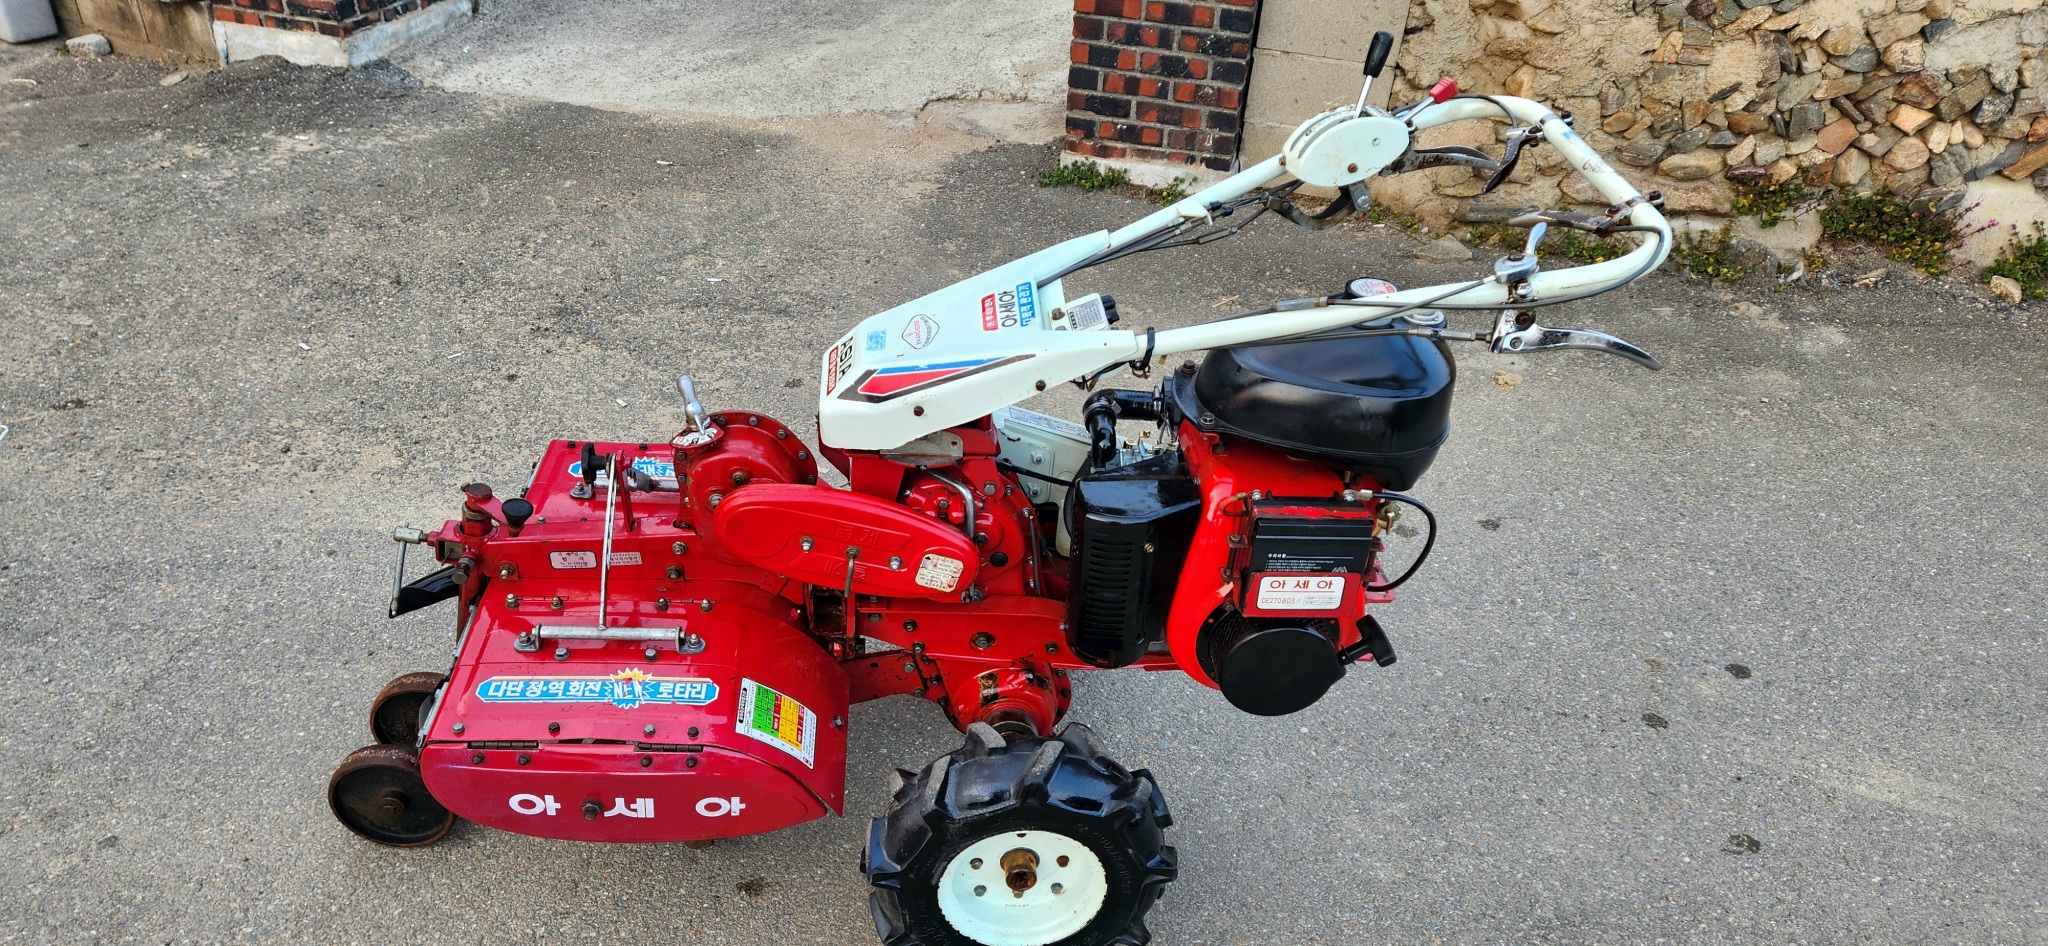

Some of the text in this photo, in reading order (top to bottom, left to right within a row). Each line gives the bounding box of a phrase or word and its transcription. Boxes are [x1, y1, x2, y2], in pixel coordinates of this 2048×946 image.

[997, 290, 1018, 328] 아세아
[838, 336, 853, 381] ASIA
[487, 680, 524, 697] 다단
[566, 680, 601, 697] 회전
[613, 680, 643, 699] NEW
[656, 682, 707, 699] 로타리
